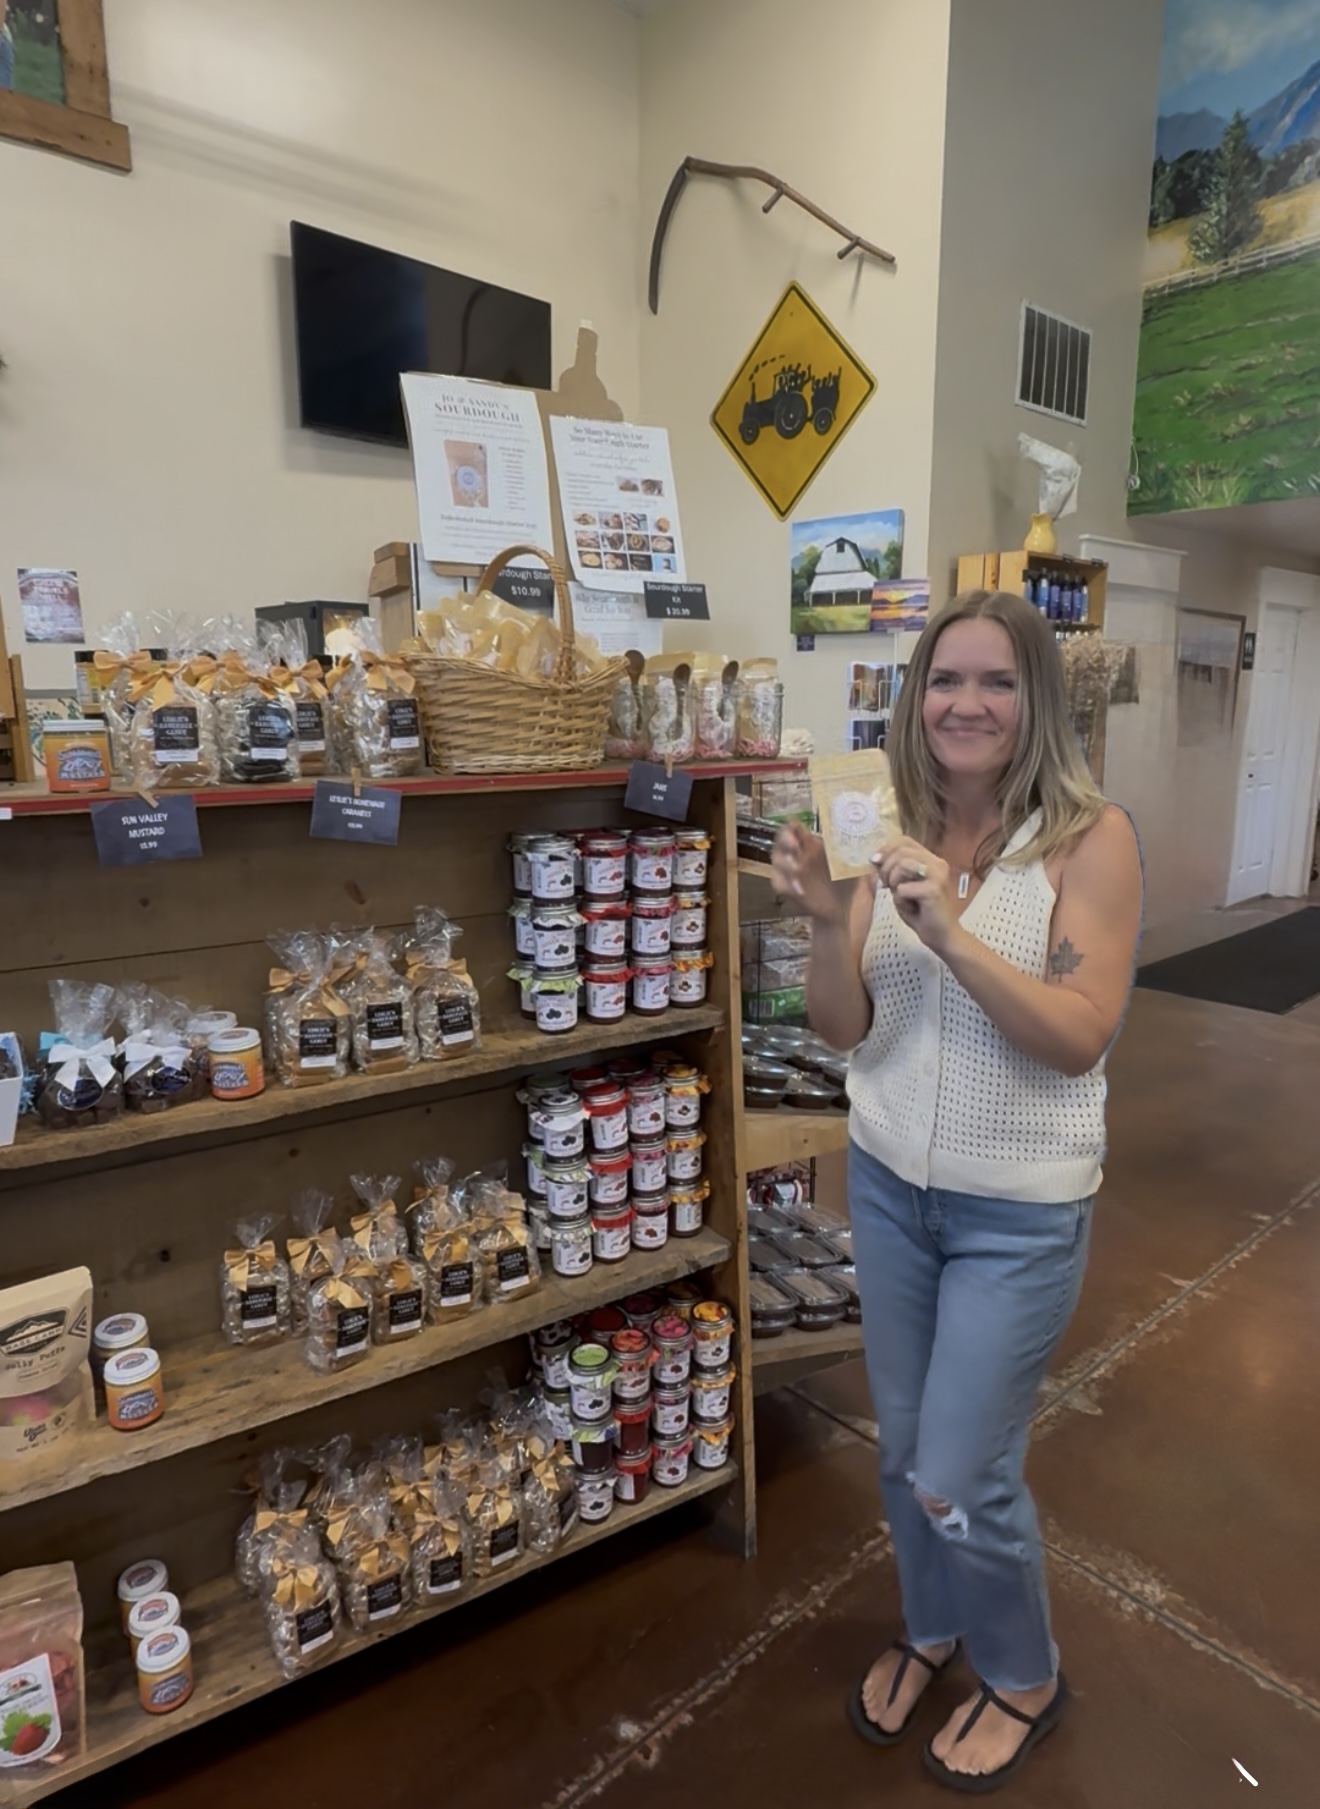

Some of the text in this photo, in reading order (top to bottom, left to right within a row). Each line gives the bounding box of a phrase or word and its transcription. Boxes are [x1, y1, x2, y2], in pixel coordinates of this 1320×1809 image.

[434, 403, 521, 423] SOURDOUGH
[511, 585, 541, 597] $10.99
[647, 583, 703, 593] Sourdough Starter
[671, 596, 682, 604] Kit
[341, 807, 373, 818] CARAMELS
[121, 813, 168, 826] SUN VALLEY
[128, 826, 166, 839] MUSTARD
[5, 1326, 63, 1352] BASE CAMP
[39, 1345, 66, 1361] Puffs
